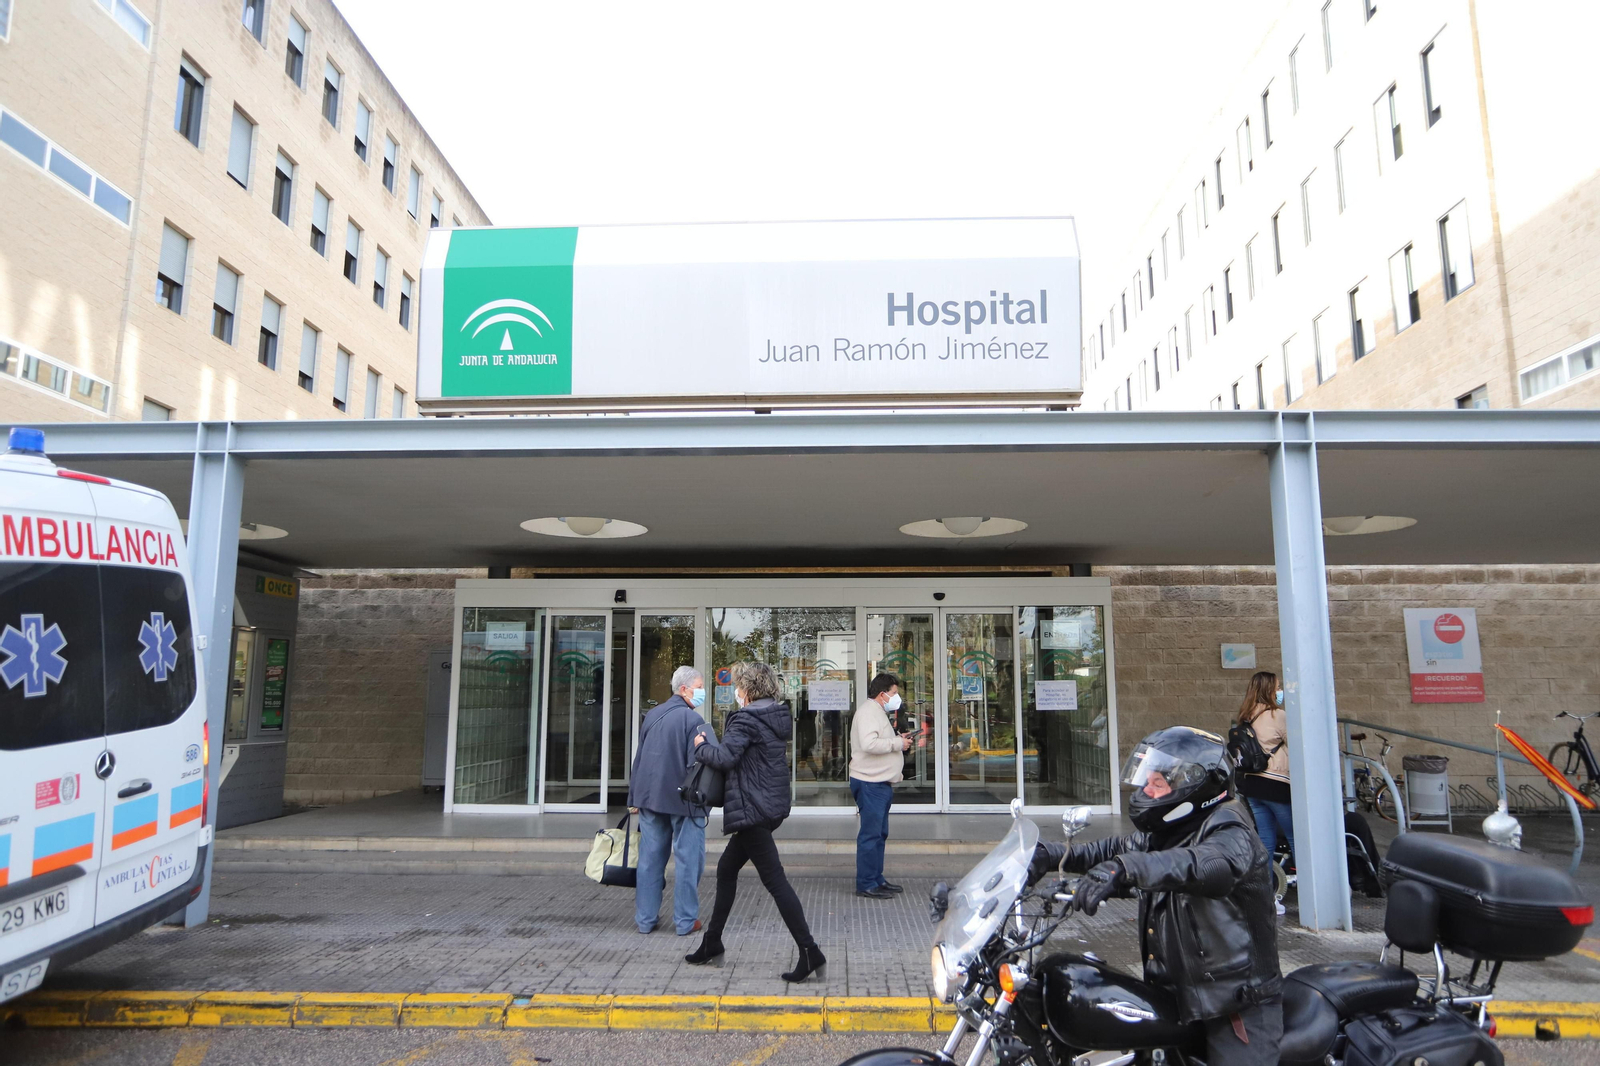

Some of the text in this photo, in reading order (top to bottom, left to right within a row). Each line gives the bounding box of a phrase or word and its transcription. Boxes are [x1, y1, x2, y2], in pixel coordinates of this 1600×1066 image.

[887, 289, 1048, 335] Hospital
[459, 354, 558, 366] JUNTA DE ANDALUCIA
[758, 336, 1049, 363] Juan Ramón Jiménez
[0, 514, 179, 568] MBULANCIA
[267, 581, 292, 595] ONCE
[1426, 658, 1437, 666] sin
[186, 747, 198, 762] 586
[133, 879, 146, 894] LA
[34, 891, 65, 920] KWG
[5, 964, 42, 997] SP
